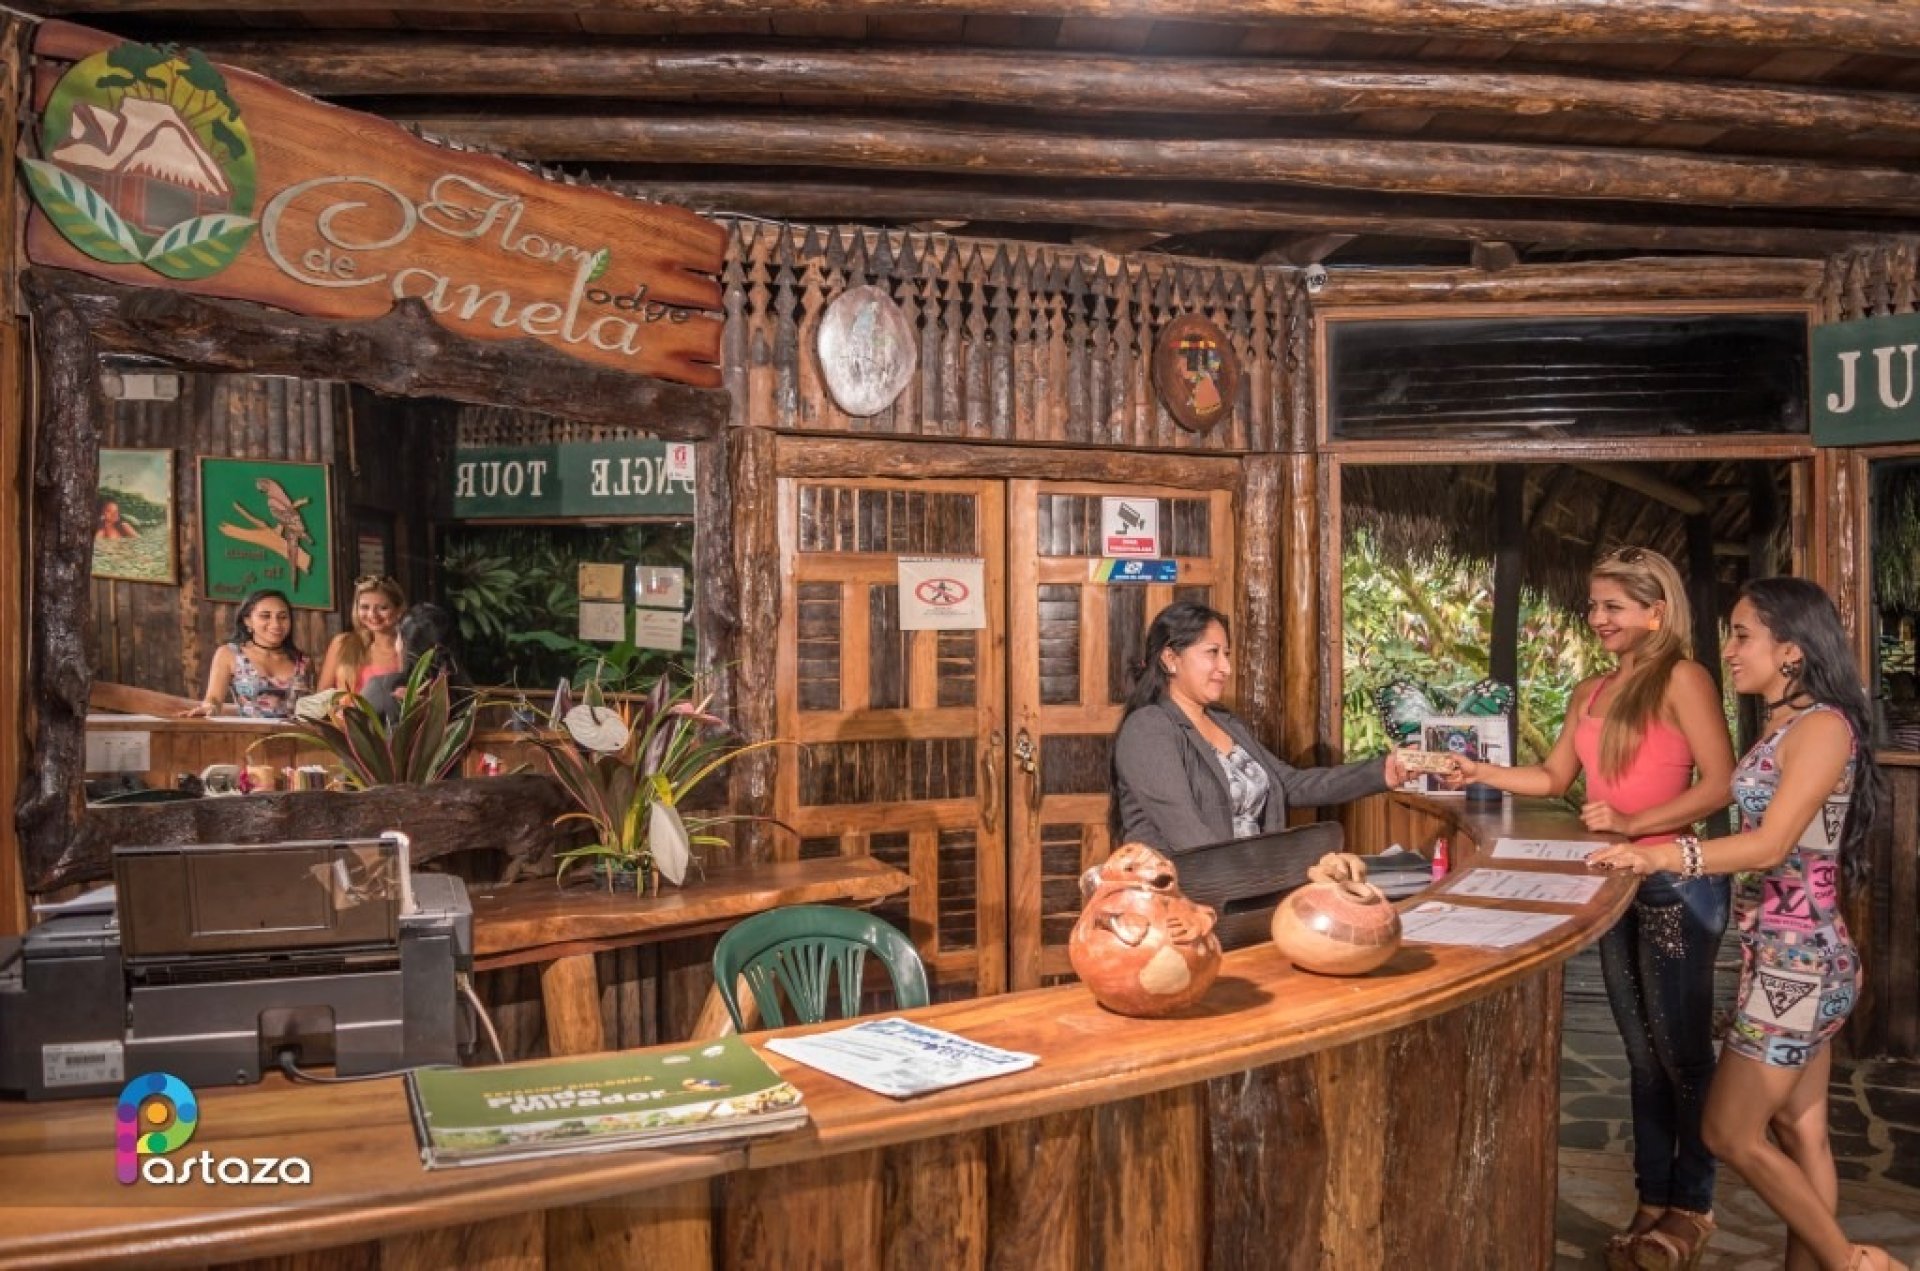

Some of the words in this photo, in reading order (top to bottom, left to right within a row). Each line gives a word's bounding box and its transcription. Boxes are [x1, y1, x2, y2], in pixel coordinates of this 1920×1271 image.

[260, 175, 642, 355] Canela
[303, 246, 356, 279] de
[1827, 344, 1919, 413] JU
